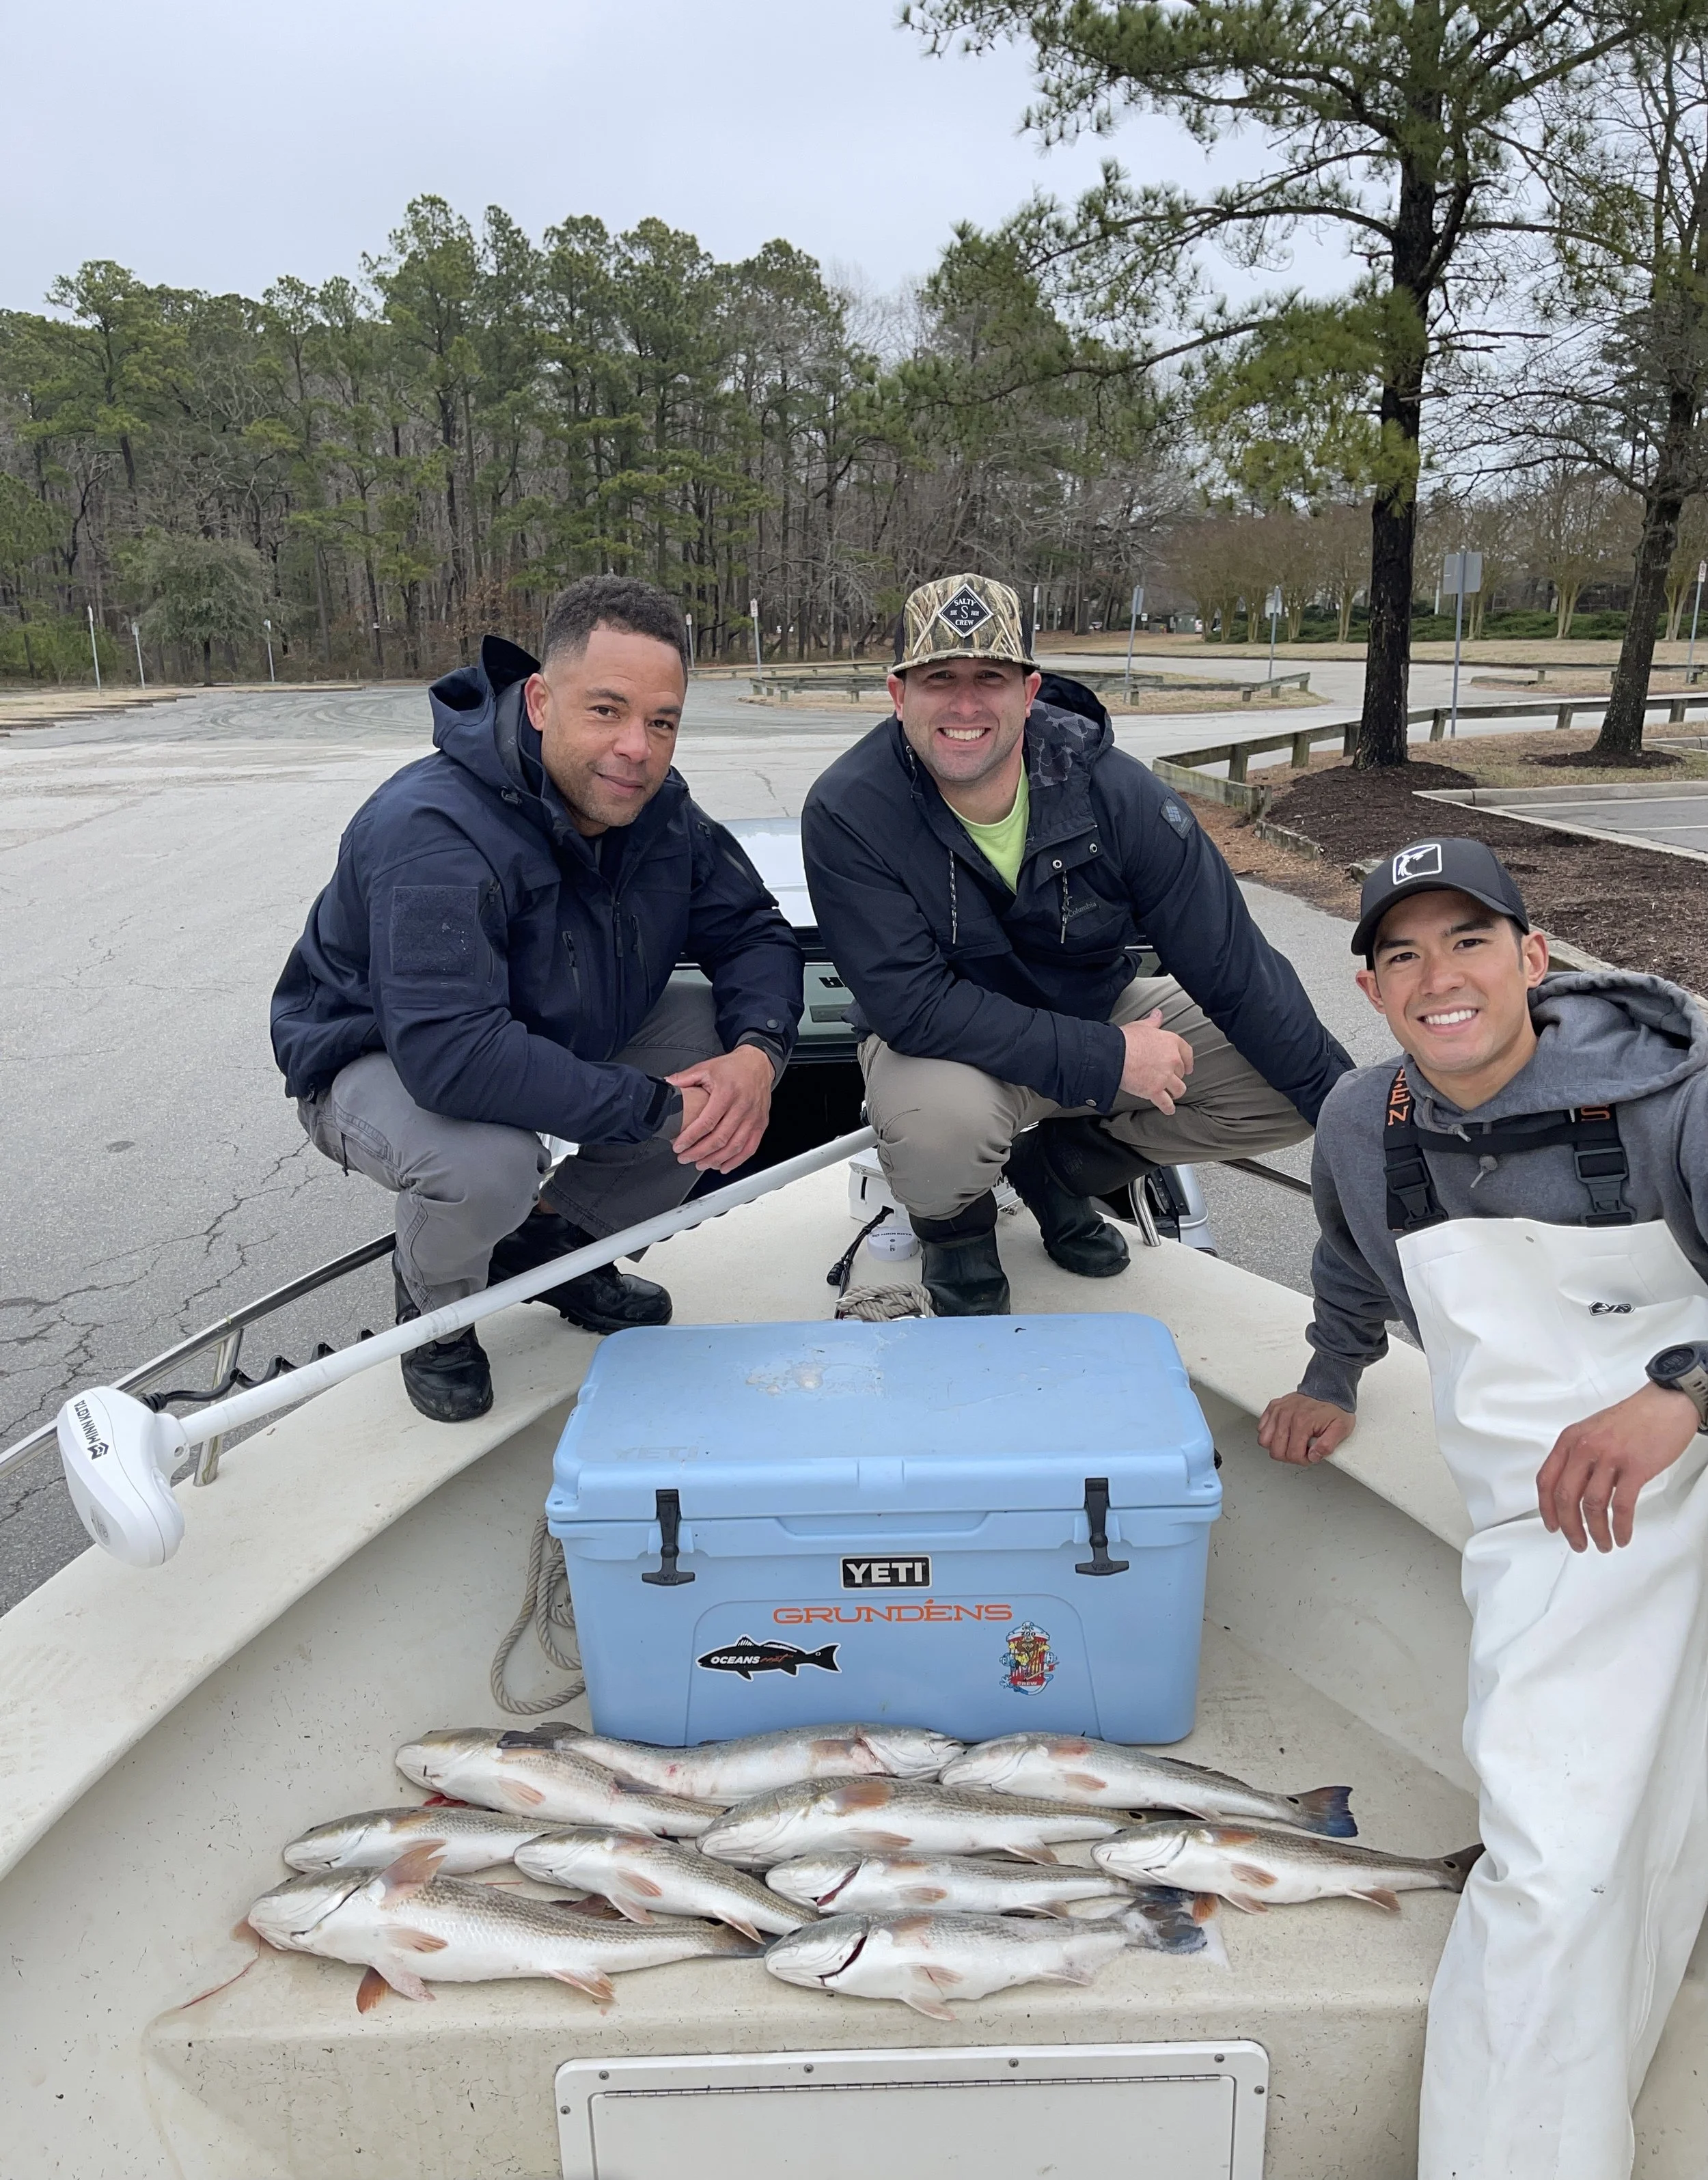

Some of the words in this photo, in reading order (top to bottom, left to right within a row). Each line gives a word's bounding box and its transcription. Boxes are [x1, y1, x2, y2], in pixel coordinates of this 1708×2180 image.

[954, 598, 976, 607] SALTY
[961, 605, 969, 619] S
[1067, 901, 1097, 917] Columbia
[73, 1399, 92, 1422] KOTA
[81, 1419, 101, 1445] MINN
[846, 1562, 923, 1584] YETI
[773, 1599, 1013, 1624] GRUNDÉNS
[711, 1655, 761, 1664] OCEANS
